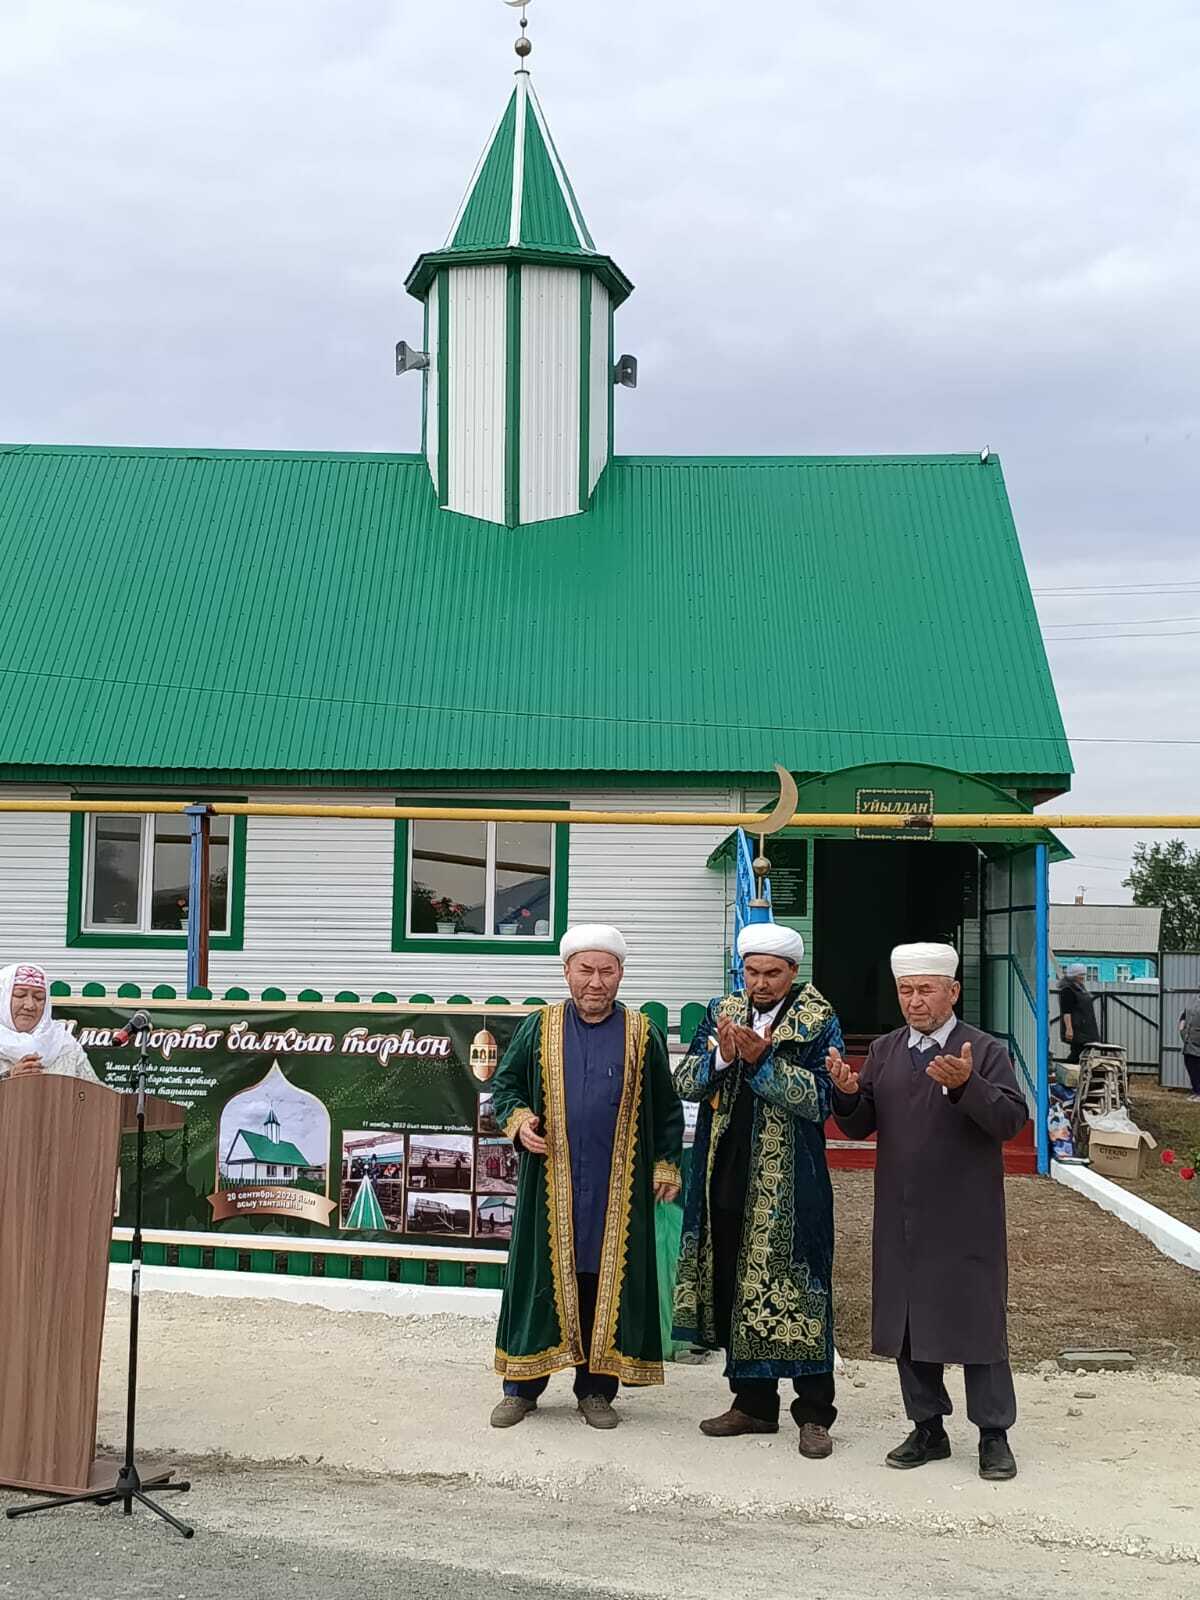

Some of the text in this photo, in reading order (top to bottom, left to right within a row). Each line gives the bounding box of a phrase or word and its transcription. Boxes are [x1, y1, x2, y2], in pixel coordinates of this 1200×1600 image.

[861, 799, 928, 814] УЙЫЛДАН
[340, 1027, 450, 1066] торһон
[226, 1192, 236, 1202] 20
[237, 1190, 274, 1200] сентябрь
